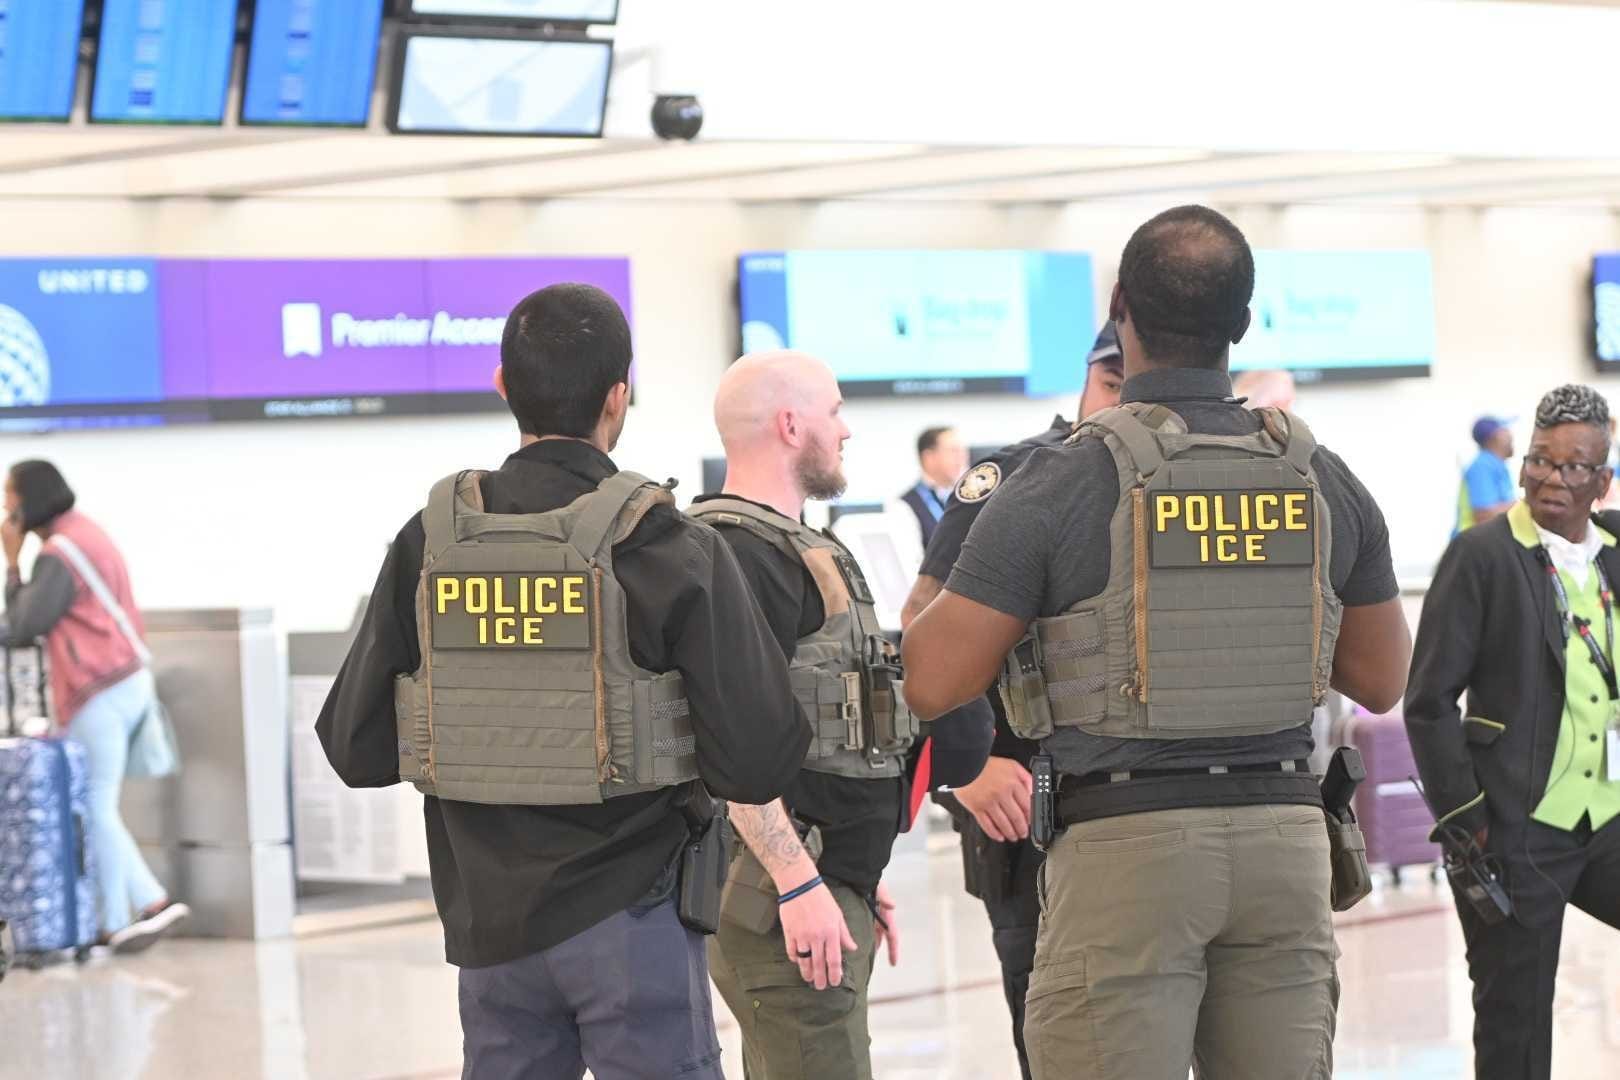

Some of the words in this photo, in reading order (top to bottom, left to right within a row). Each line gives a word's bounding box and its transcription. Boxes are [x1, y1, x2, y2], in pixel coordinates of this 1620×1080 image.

[38, 269, 149, 294] UNITED
[332, 312, 430, 346] Premier
[1156, 494, 1307, 532] POLICE
[1200, 534, 1266, 562] ICE
[436, 577, 585, 614] POLICE
[479, 617, 544, 644] ICE
